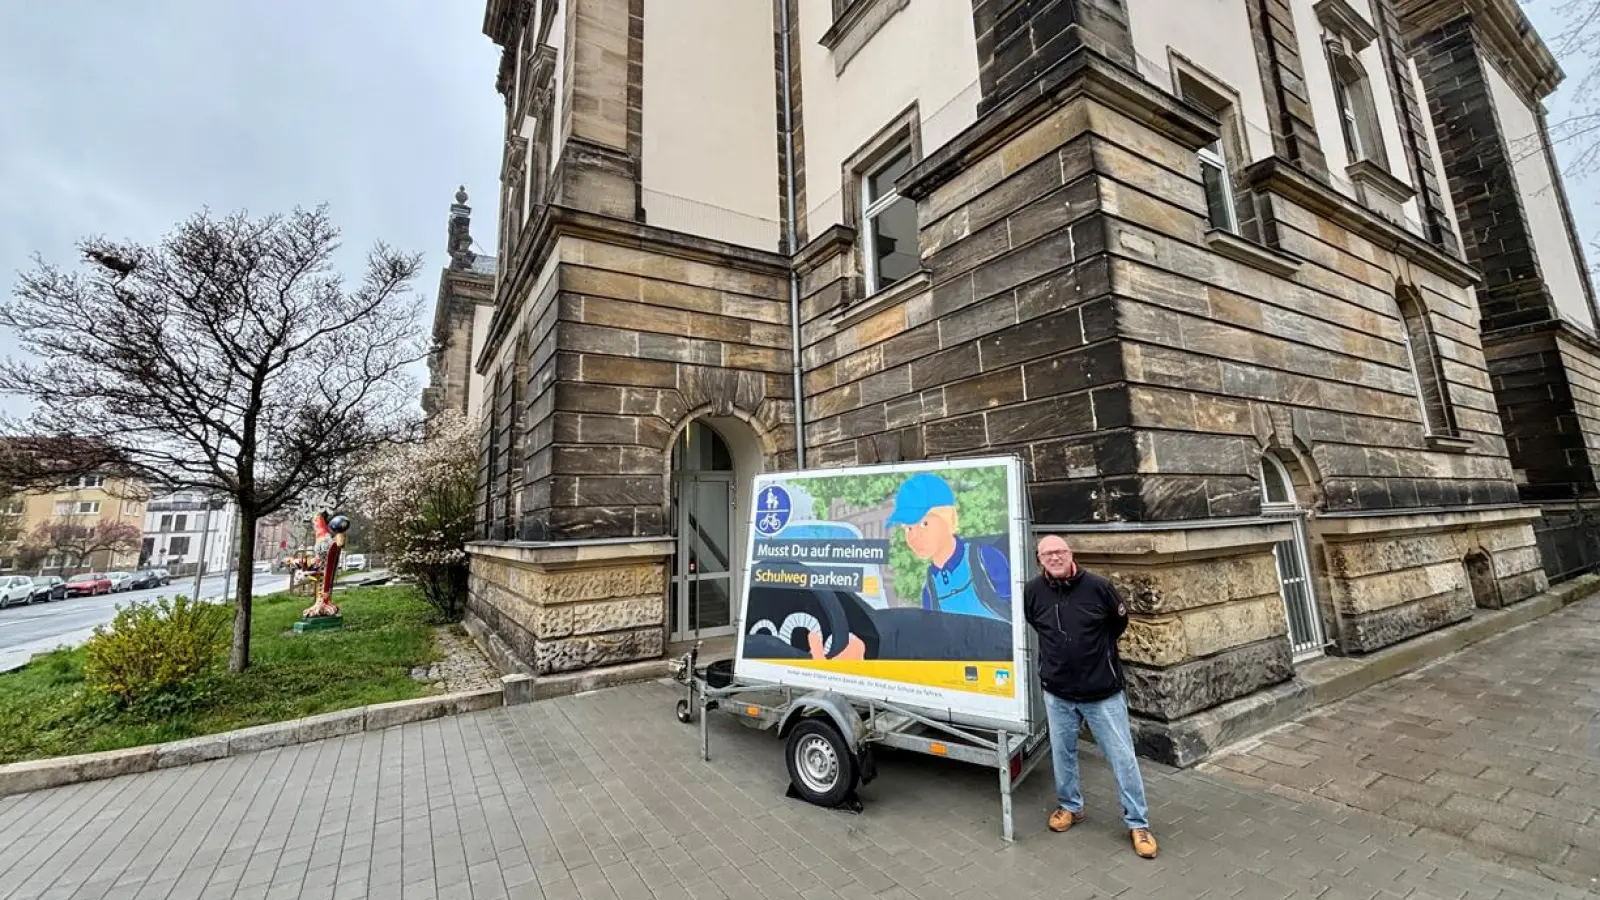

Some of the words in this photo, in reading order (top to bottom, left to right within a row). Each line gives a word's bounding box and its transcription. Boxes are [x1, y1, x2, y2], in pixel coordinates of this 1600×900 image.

[757, 543, 790, 557] Musst
[791, 544, 808, 557] Du
[810, 544, 831, 558] auf
[832, 544, 884, 559] meinem
[755, 568, 808, 587] Schulweg
[809, 571, 860, 588] parken?
